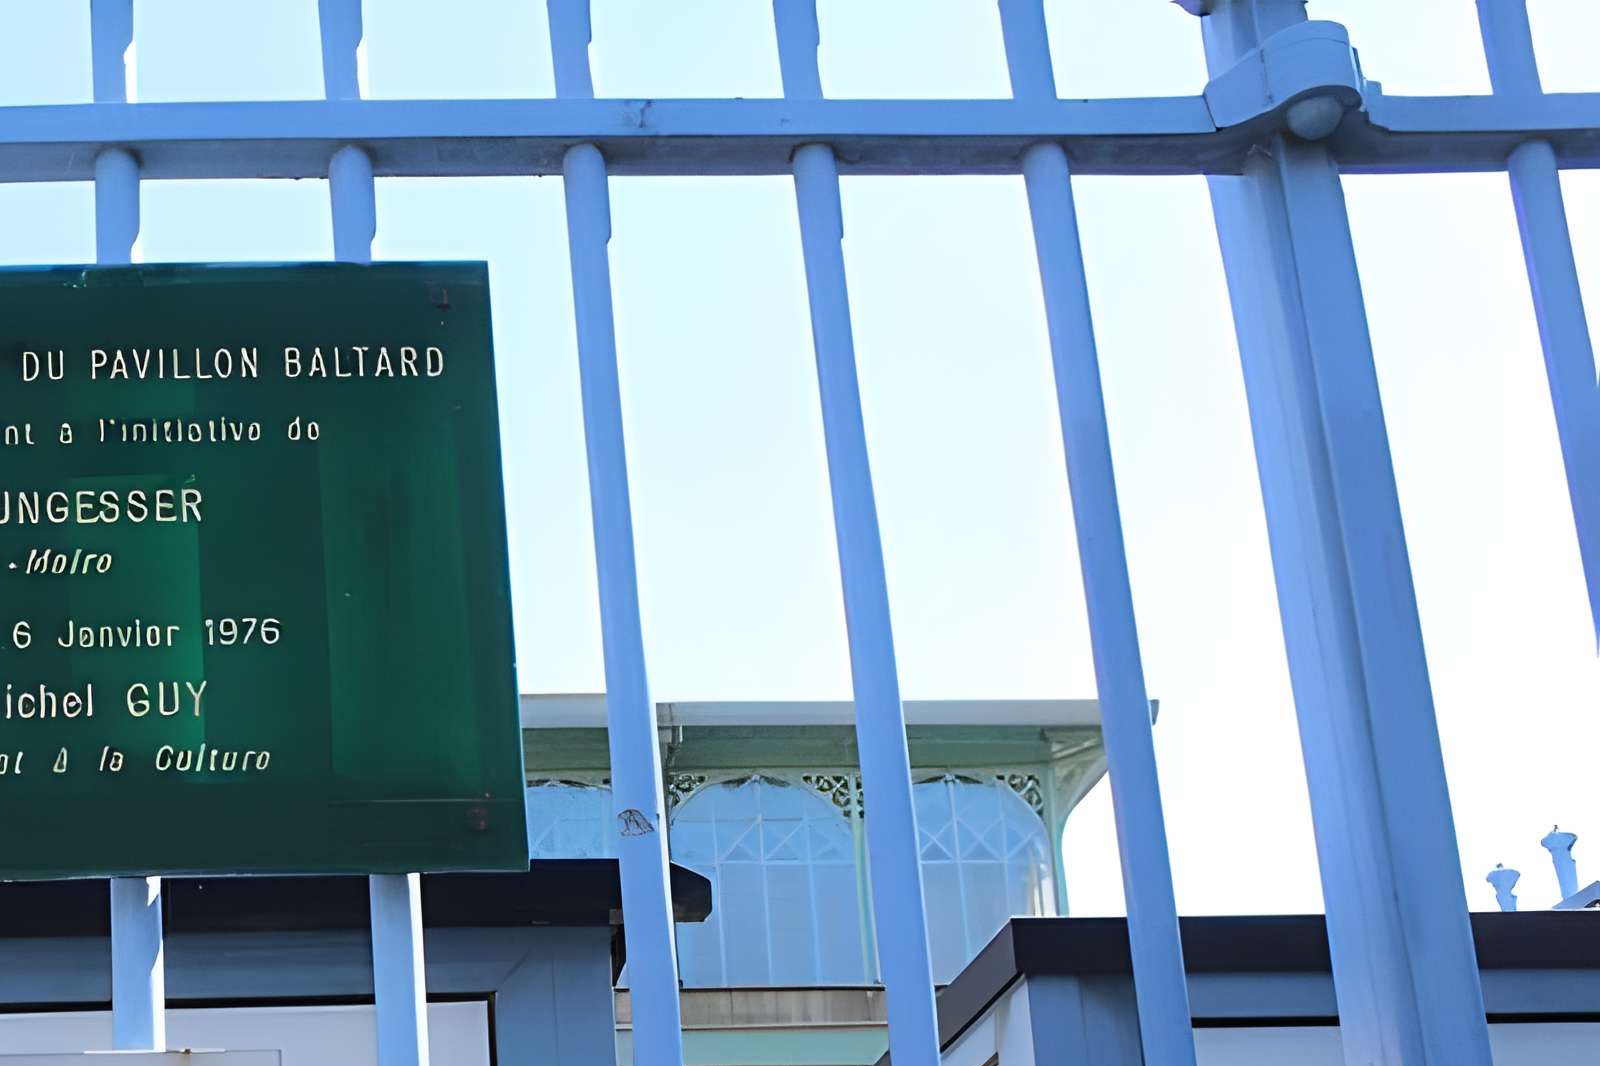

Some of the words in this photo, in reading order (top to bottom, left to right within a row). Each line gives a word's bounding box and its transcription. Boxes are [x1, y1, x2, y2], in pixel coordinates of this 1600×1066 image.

[22, 349, 64, 382] DU
[91, 347, 258, 380] PAVILLON
[284, 346, 444, 378] BALTARD
[12, 620, 32, 649] 6
[205, 617, 281, 646] 1976
[126, 680, 207, 718] GUY
[99, 745, 124, 772] la
